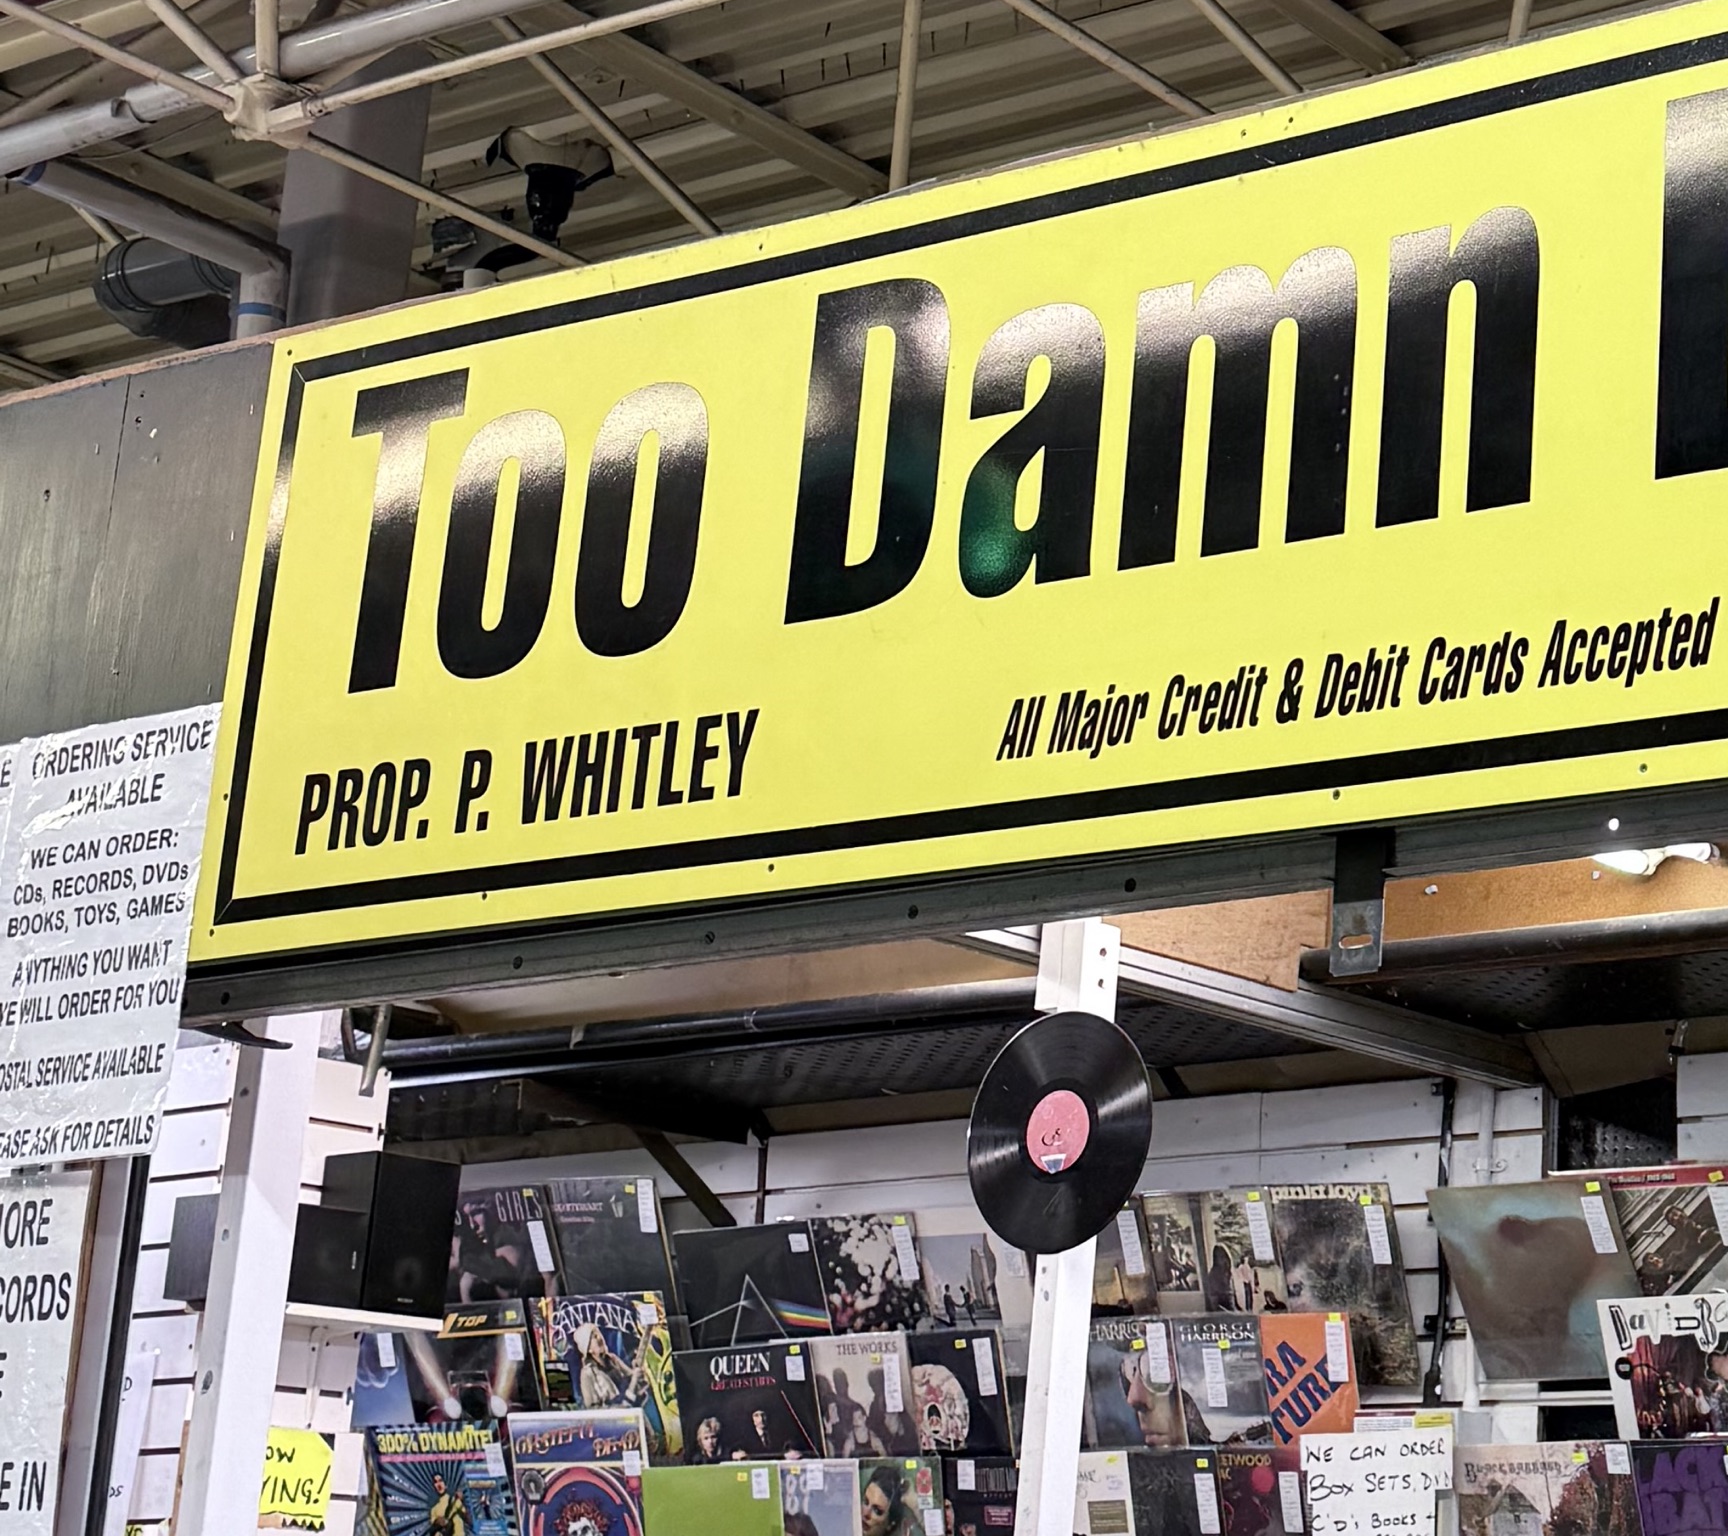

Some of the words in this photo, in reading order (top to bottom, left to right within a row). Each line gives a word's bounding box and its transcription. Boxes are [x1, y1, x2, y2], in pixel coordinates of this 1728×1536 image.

[348, 367, 711, 695] Too
[783, 204, 1542, 626] Damn
[997, 699, 1042, 760] All
[1048, 684, 1149, 759] Major
[1158, 666, 1268, 740] Credit
[1277, 658, 1304, 722] &
[1315, 645, 1409, 719] Debit
[1418, 631, 1529, 705] Cards
[1538, 597, 1721, 688] Accepted
[33, 736, 126, 780] ORDERING
[130, 720, 214, 762] SERVICE
[66, 773, 164, 817] AVAILABLE
[295, 771, 429, 856] PROP.
[456, 750, 490, 832] P.
[521, 709, 760, 825] WHITLEY
[30, 846, 59, 870] WE
[62, 839, 100, 864] CAN
[106, 829, 179, 859] ORDER:
[14, 882, 46, 907] CDs,
[52, 870, 138, 901] RECORDS,
[142, 861, 188, 888] DVDs
[8, 911, 68, 939] BOOKS,
[74, 902, 120, 931] TOYS,
[126, 891, 185, 921] GAMES
[12, 950, 88, 987] ANYTHING
[93, 948, 125, 975] YOU
[128, 939, 173, 970] WANT
[20, 995, 53, 1024] WILL
[58, 988, 111, 1018] ORDER
[114, 986, 144, 1013] FOR
[148, 978, 179, 1009] YOU
[36, 1052, 90, 1089] SERVICE
[92, 1043, 165, 1081] AVAILABLE
[31, 1125, 59, 1155] ASK
[62, 1121, 90, 1152] FOR
[93, 1114, 154, 1150] DETAILS
[496, 1190, 543, 1222] GIRLS
[550, 1301, 640, 1339] SANTANA
[1180, 1331, 1255, 1342] HARRISON
[710, 1353, 770, 1377] QUEEN
[836, 1343, 861, 1356] THE
[866, 1339, 898, 1355] WORKS
[1306, 1446, 1333, 1463] WE
[1350, 1444, 1387, 1461] CAN
[1400, 1438, 1445, 1456] ORDER
